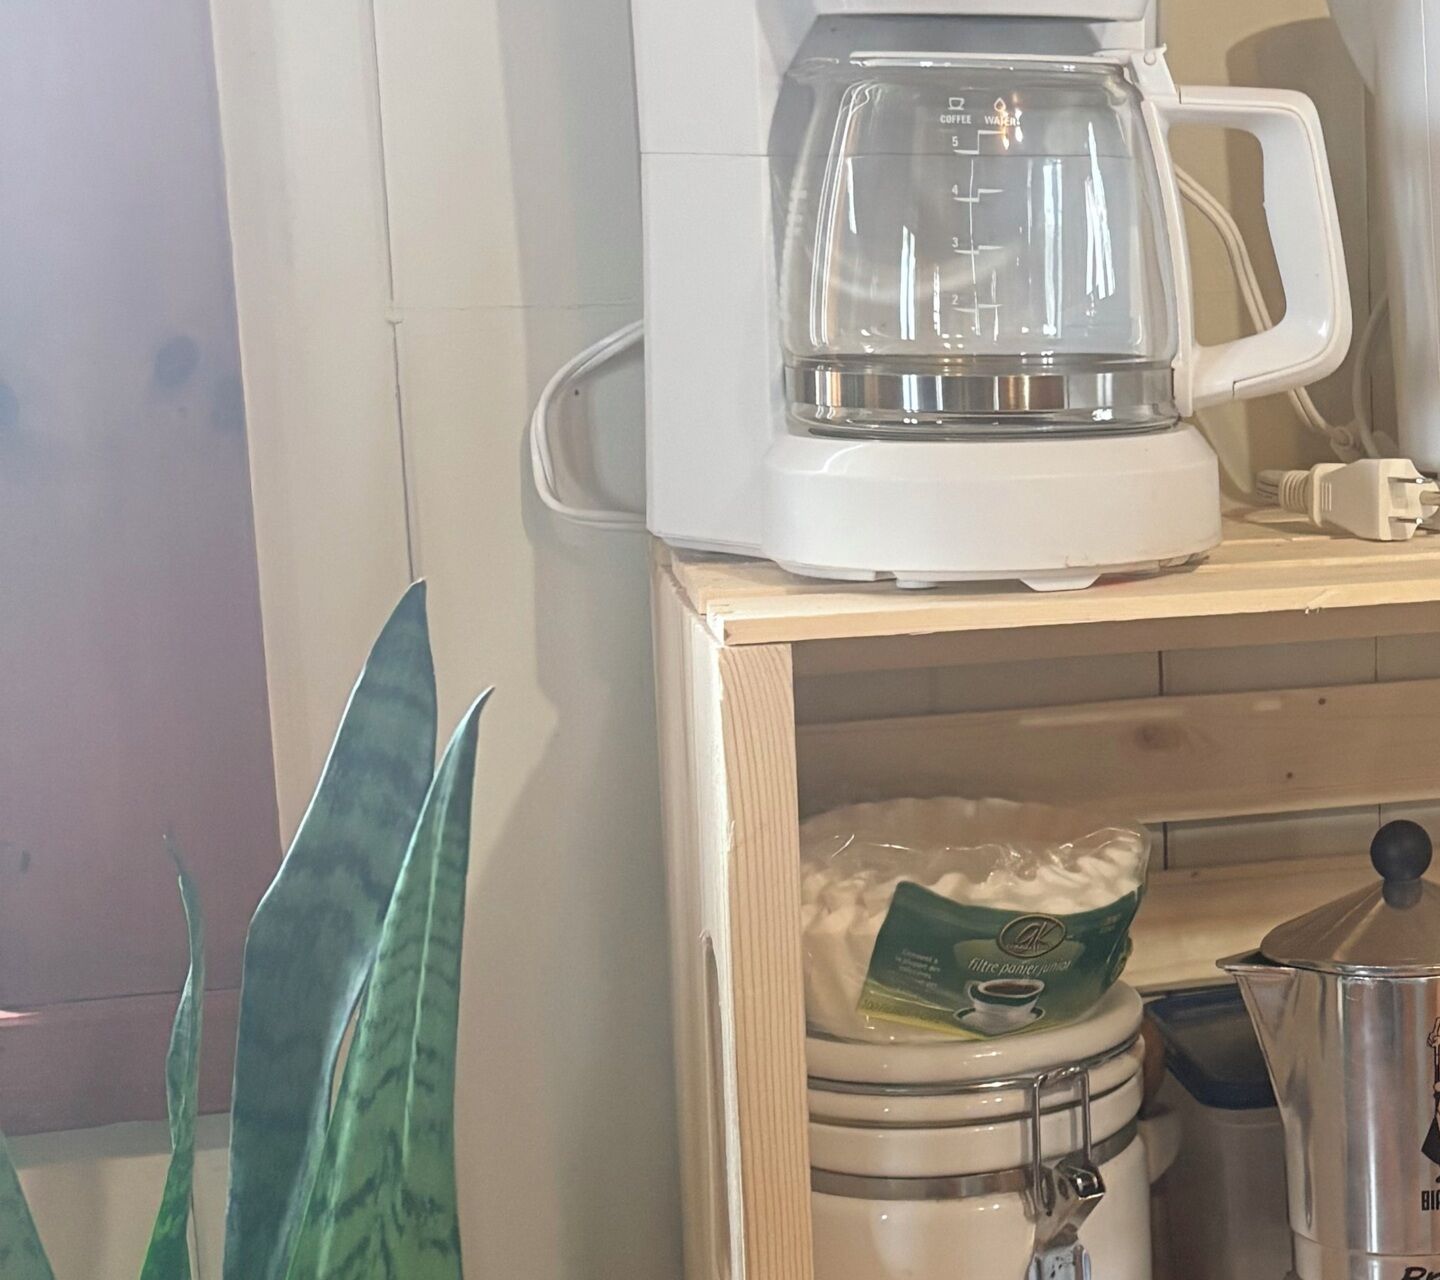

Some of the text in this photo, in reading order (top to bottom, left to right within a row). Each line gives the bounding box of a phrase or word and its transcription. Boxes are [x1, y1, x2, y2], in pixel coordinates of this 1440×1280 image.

[939, 114, 972, 125] COFFEE
[951, 135, 959, 147] 5
[951, 184, 959, 195] 4
[951, 237, 959, 248] 3
[951, 294, 959, 305] 2
[968, 956, 1000, 973] filtre
